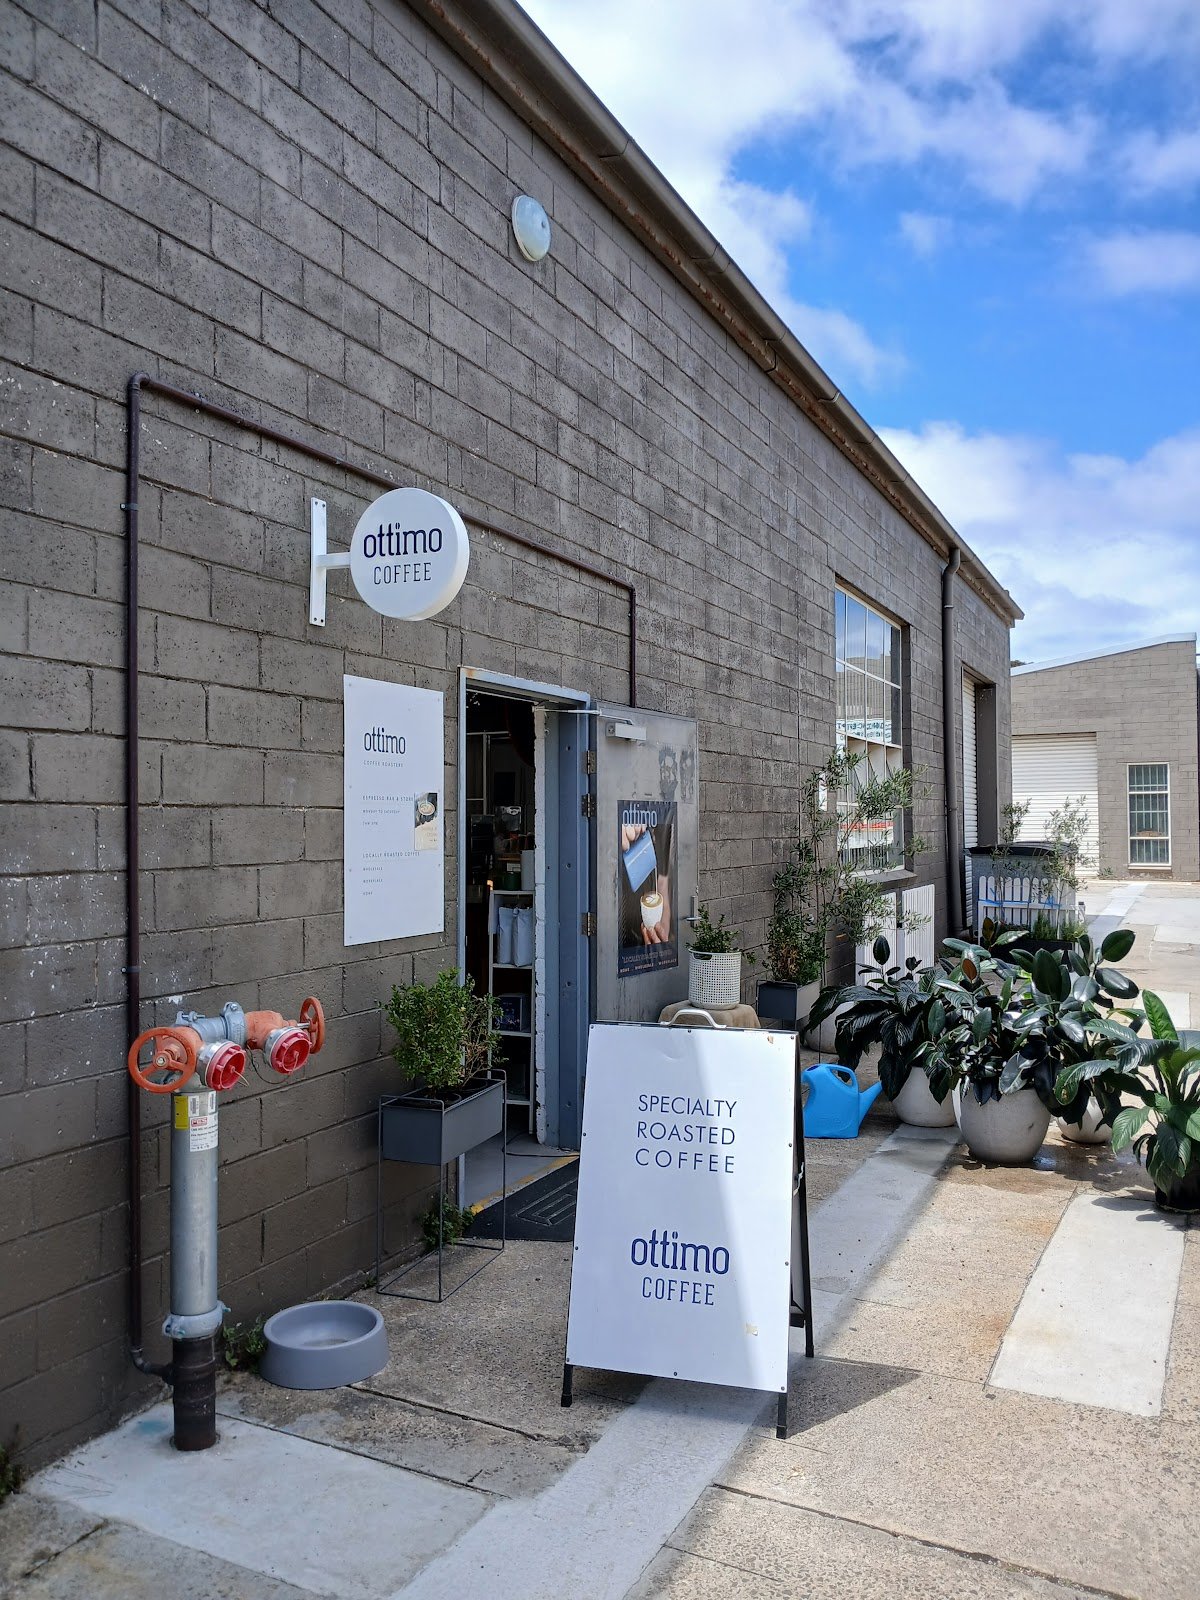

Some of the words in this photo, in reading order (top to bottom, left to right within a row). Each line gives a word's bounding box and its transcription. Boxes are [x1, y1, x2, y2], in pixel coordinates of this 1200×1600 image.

[363, 522, 442, 558] ottimo
[373, 562, 432, 585] COFFEE
[363, 726, 406, 755] ottimo
[622, 803, 658, 828] ottimo
[638, 1094, 737, 1118] SPECIALTY
[637, 1121, 735, 1145] ROASTED
[635, 1148, 735, 1174] COFFEE
[631, 1228, 730, 1275] ottimo
[642, 1276, 715, 1306] COFFEE
